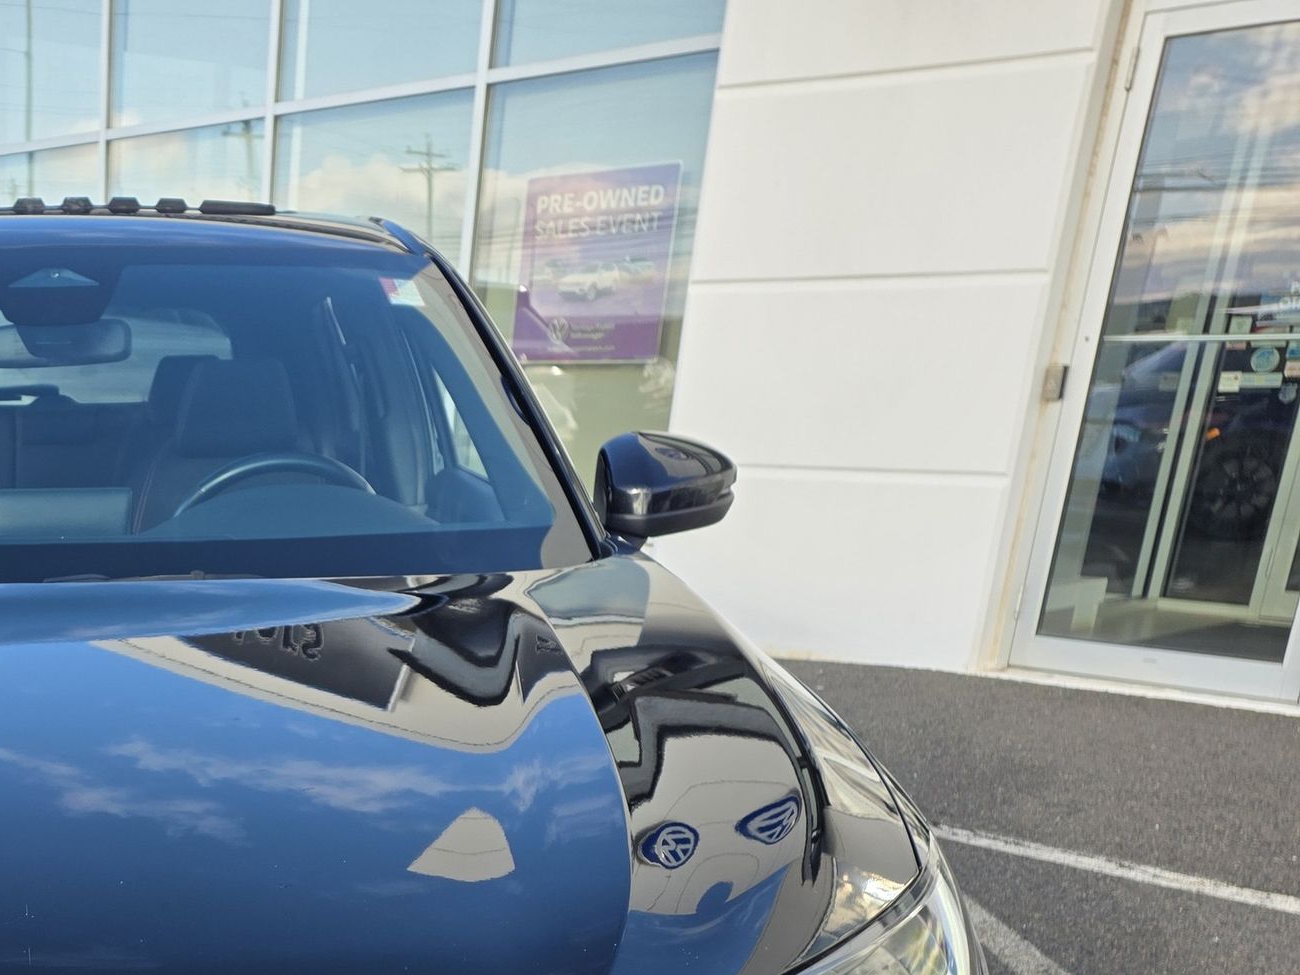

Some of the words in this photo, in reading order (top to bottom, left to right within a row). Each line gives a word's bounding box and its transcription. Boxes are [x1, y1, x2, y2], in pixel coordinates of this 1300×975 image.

[536, 184, 665, 214] PRE-OWNED
[535, 216, 592, 240] SALES
[595, 211, 663, 236] EVENT
